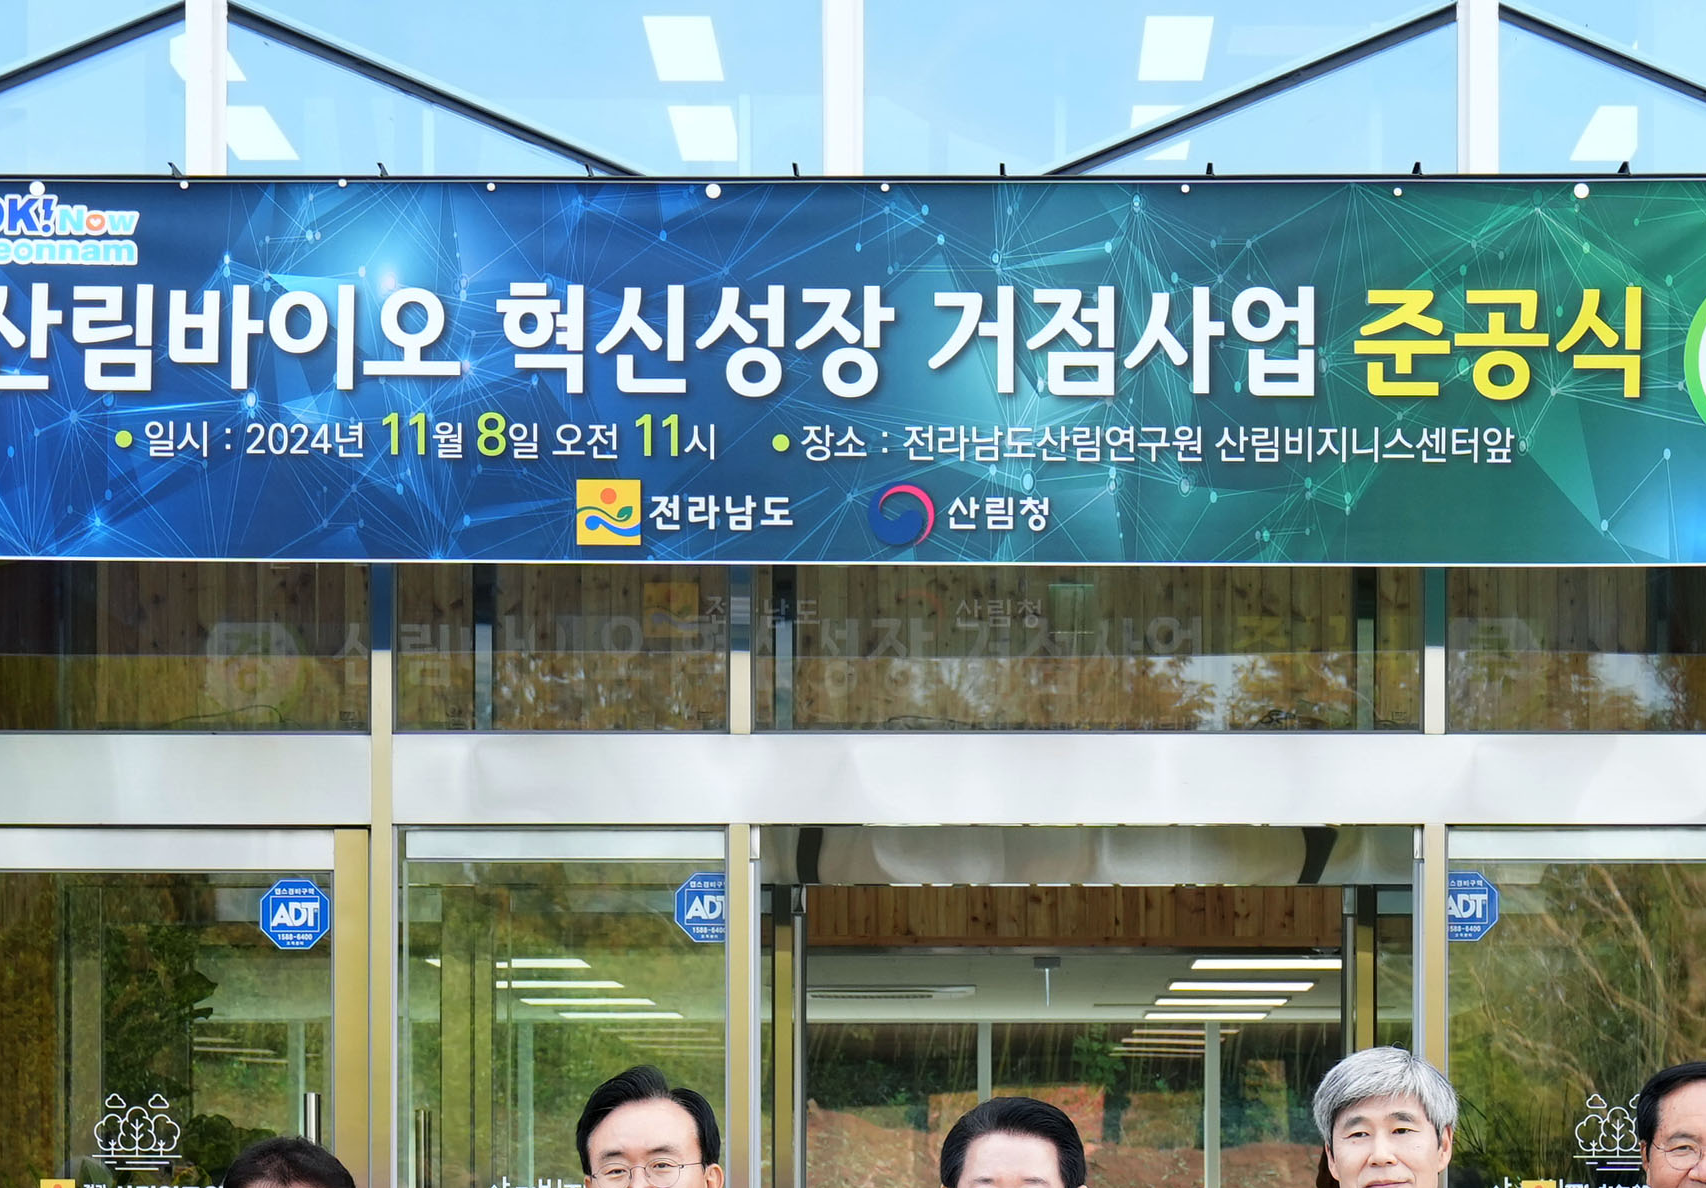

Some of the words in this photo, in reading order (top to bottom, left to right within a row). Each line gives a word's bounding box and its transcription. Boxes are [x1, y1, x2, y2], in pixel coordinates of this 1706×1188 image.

[56, 205, 137, 233] Now
[496, 283, 895, 397] 혁신성장
[927, 286, 1316, 396] 거점사업
[1354, 286, 1643, 400] 준공식
[144, 421, 208, 458] 일시
[246, 422, 364, 458] 2024년
[382, 412, 463, 459] 11월
[476, 412, 539, 459] 8일
[552, 423, 618, 459] 오전
[635, 413, 716, 460] 11시
[801, 425, 868, 461] 장소
[903, 425, 1202, 462] 전라남도산림연구원
[1215, 426, 1515, 463] 산림비지니스센터앞
[649, 495, 794, 531] 전라남도
[948, 496, 1050, 532] 산림청
[270, 901, 320, 927] ADT
